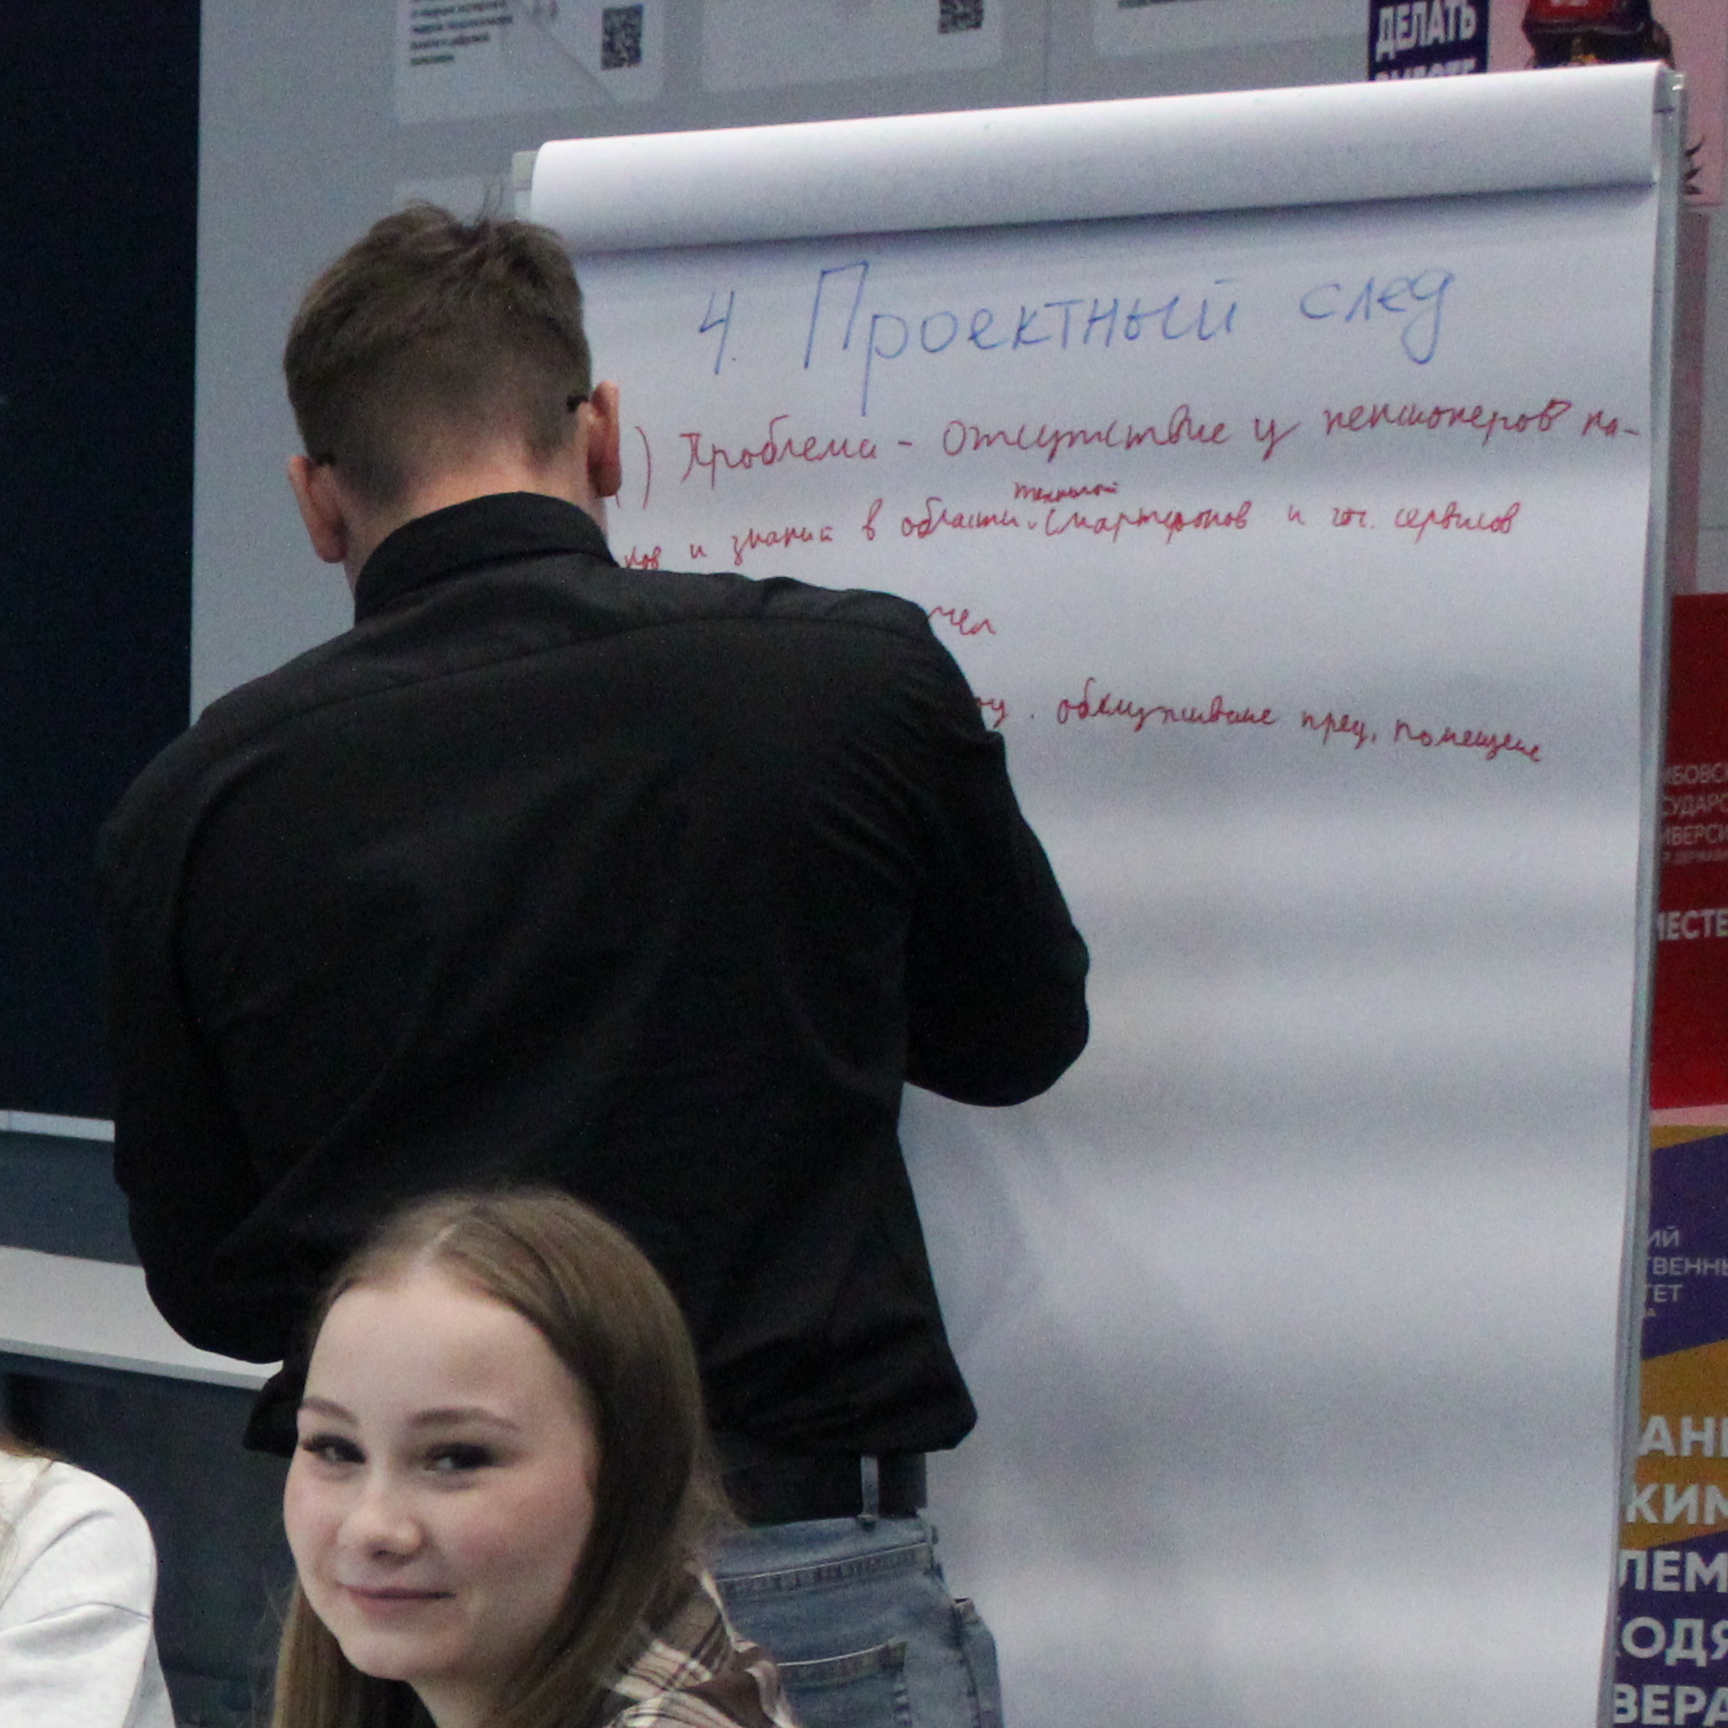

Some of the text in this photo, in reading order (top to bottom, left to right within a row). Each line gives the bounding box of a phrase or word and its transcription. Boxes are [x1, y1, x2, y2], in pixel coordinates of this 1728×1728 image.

[1375, 0, 1478, 62] ДЕЛАТЬ
[803, 261, 1238, 416] Проектный
[1299, 268, 1455, 364] след
